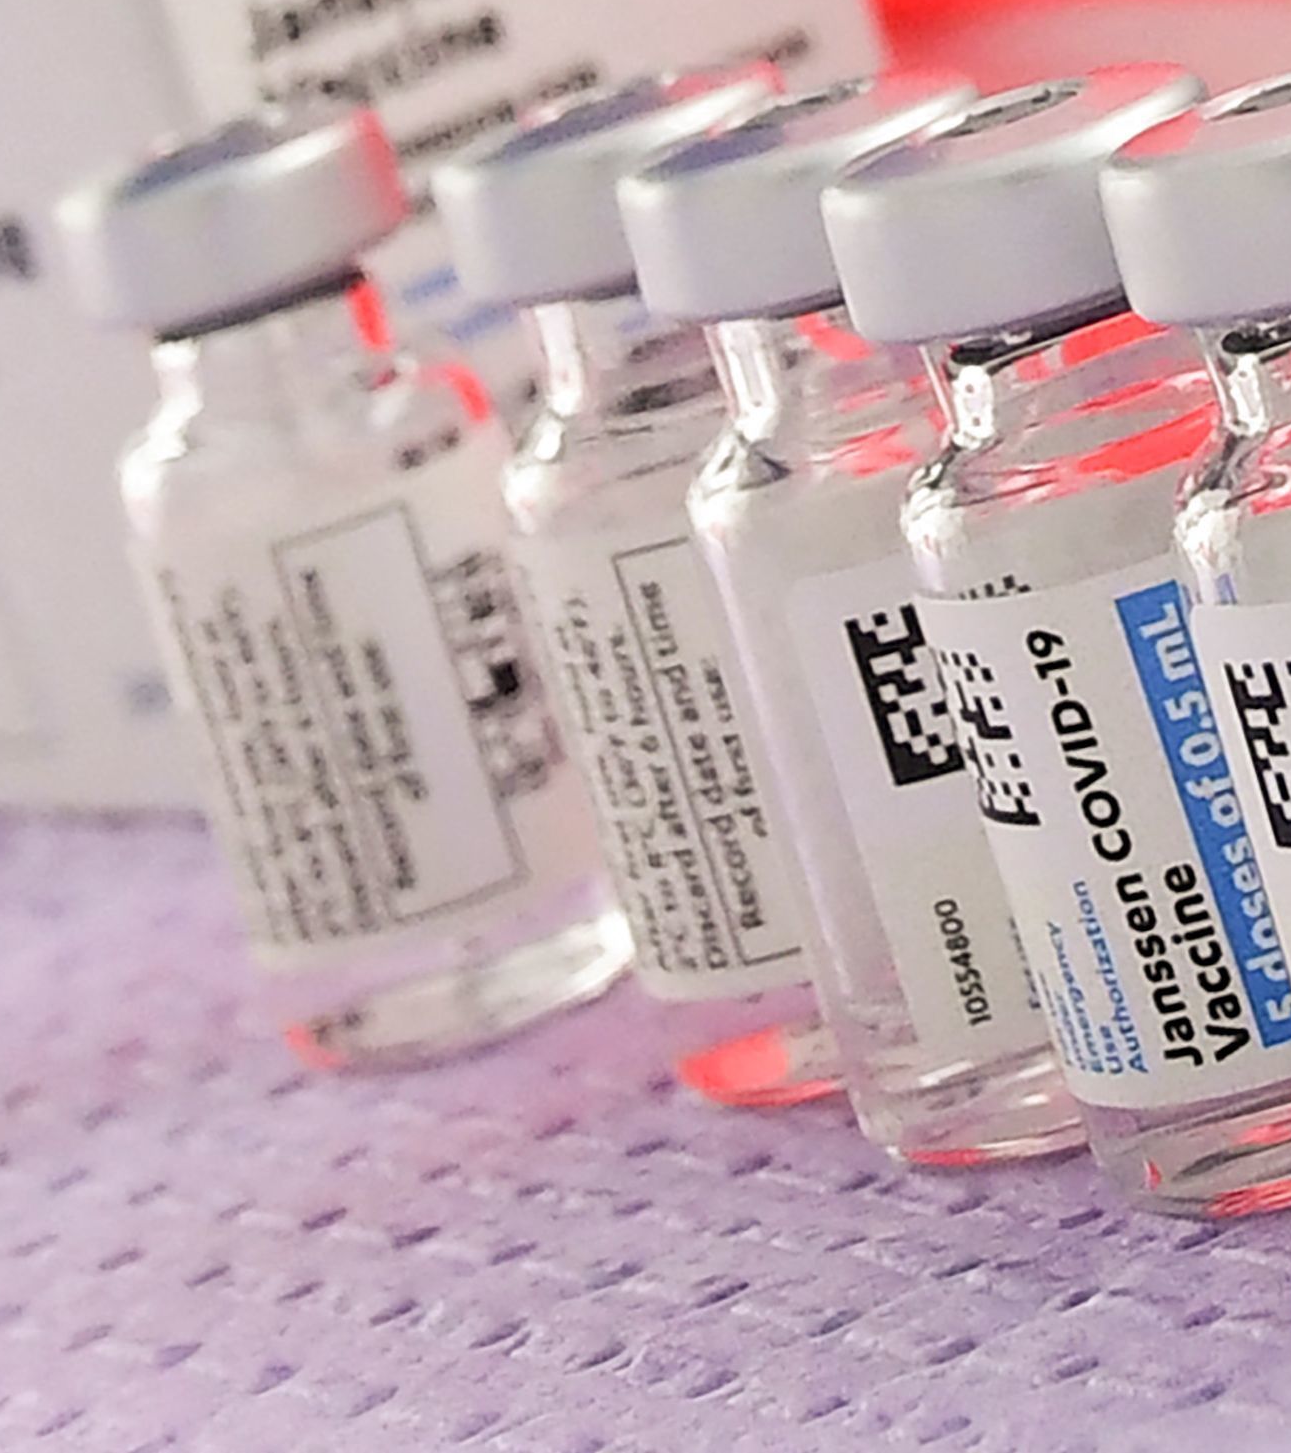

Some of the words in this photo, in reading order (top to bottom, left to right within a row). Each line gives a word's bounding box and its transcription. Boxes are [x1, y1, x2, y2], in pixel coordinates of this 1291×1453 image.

[638, 578, 679, 658] time
[1137, 601, 1198, 683] mL
[660, 661, 701, 724] and
[1024, 627, 1133, 863] COVID-19
[1164, 689, 1223, 769] 0.5
[688, 730, 724, 808] date
[1184, 774, 1243, 827] of
[709, 811, 765, 932] Record
[1222, 836, 1290, 984] doses
[933, 899, 993, 1026] 10554800
[1072, 878, 1150, 1076] Authorization
[1115, 869, 1205, 1068] Janssen
[1162, 860, 1251, 1063] Vaccine
